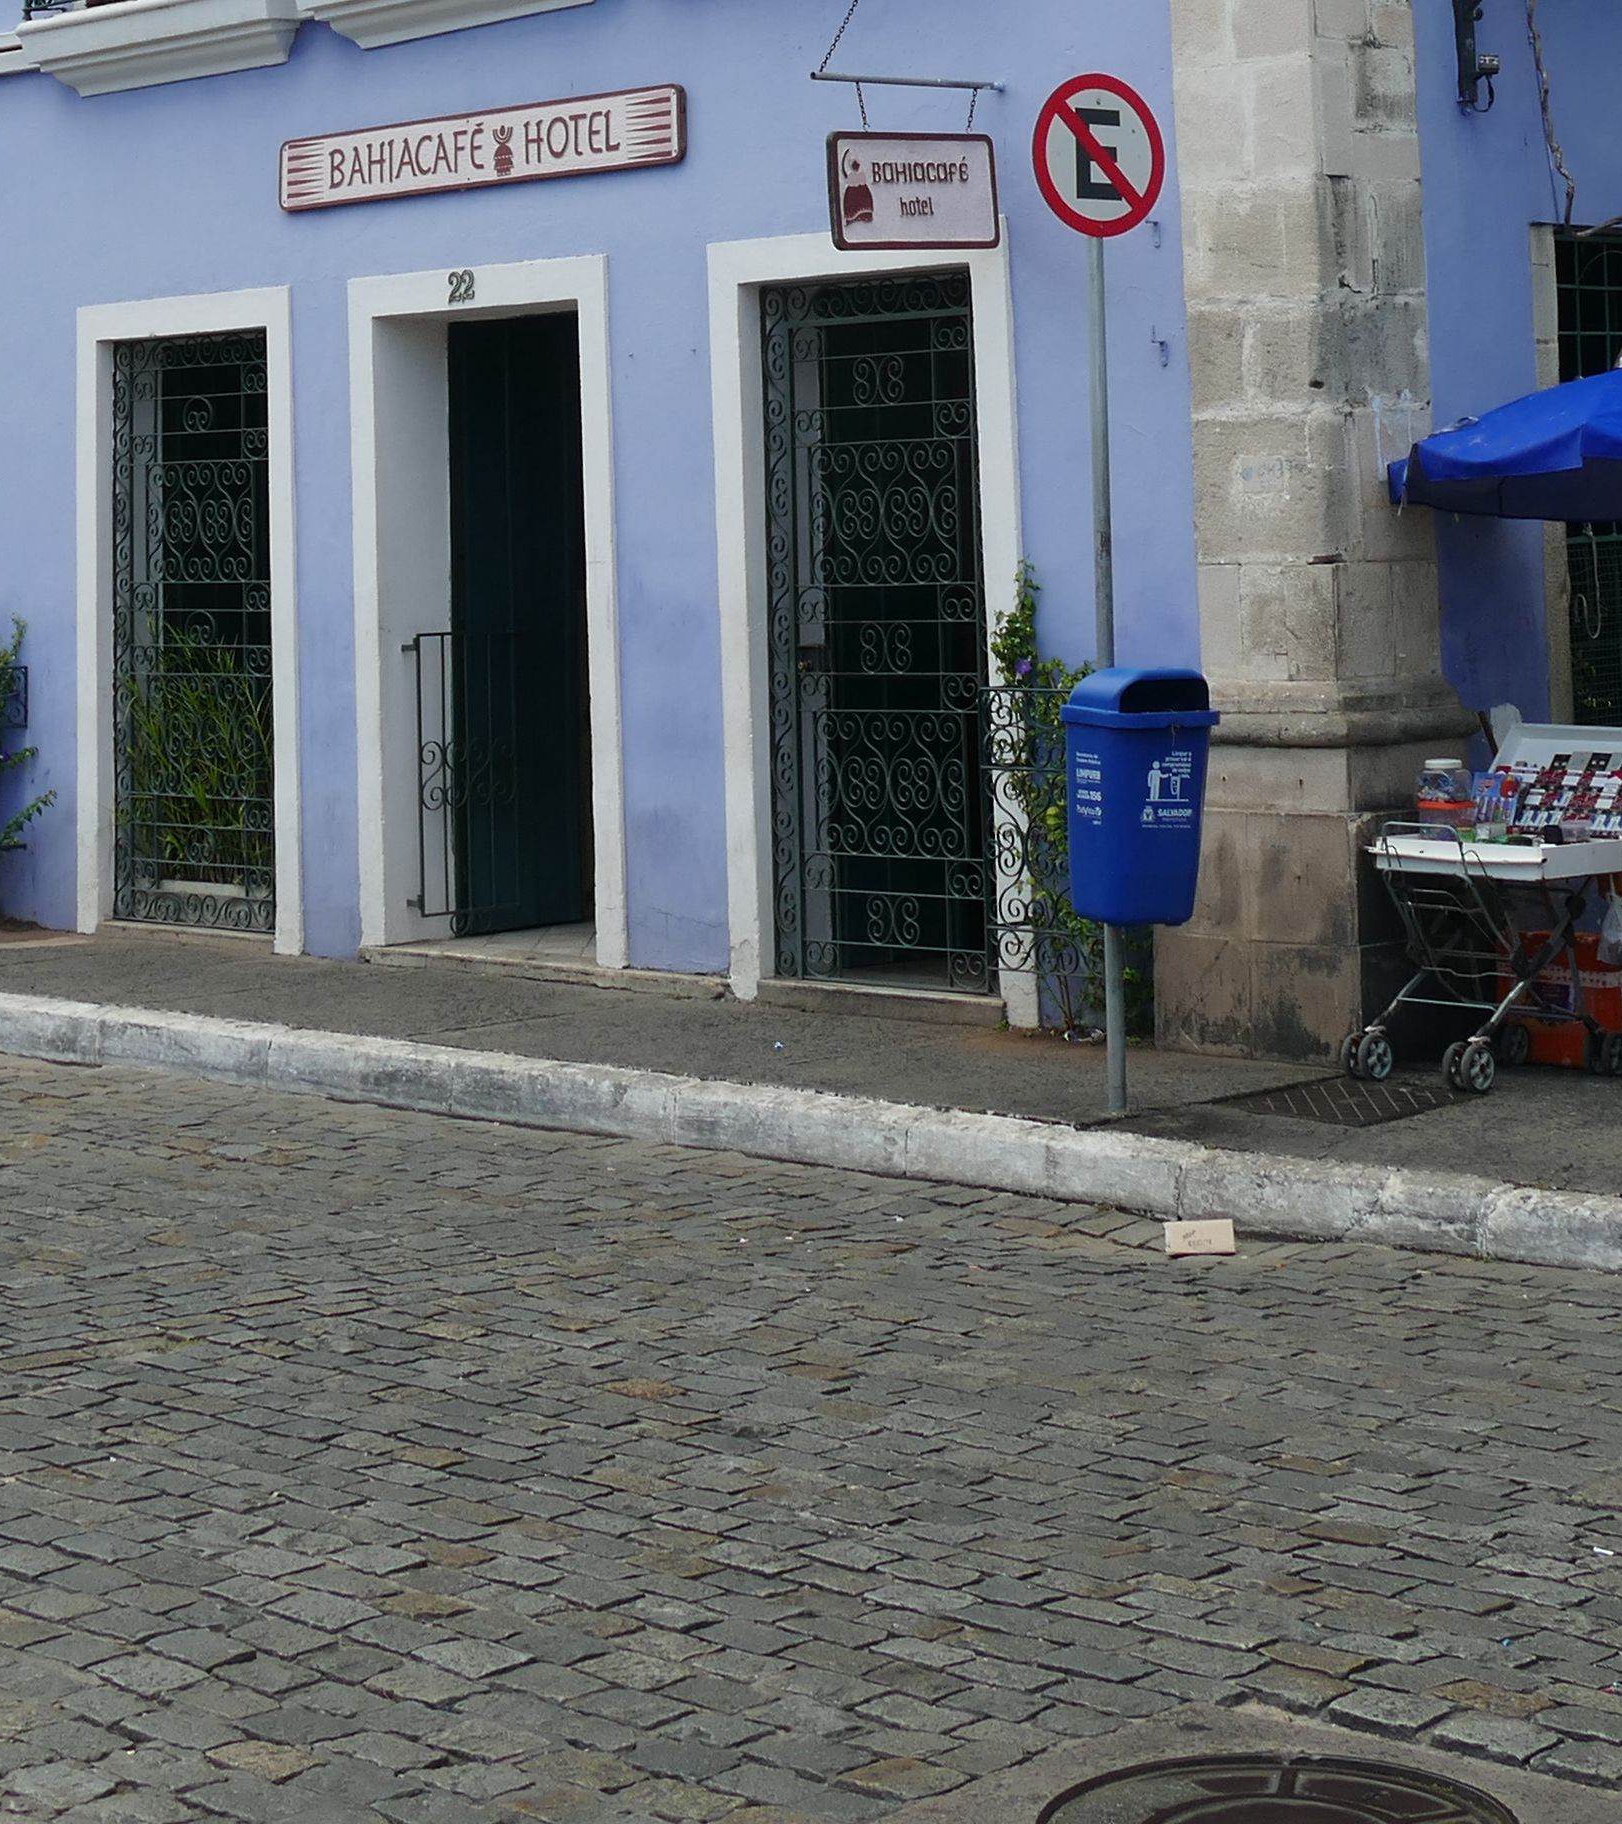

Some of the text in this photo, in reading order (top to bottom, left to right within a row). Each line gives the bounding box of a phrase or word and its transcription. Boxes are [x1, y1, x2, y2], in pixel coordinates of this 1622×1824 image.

[328, 109, 621, 190] BAHIACAFÉ HOTEL
[899, 196, 934, 217] hotel
[448, 269, 475, 304] 22
